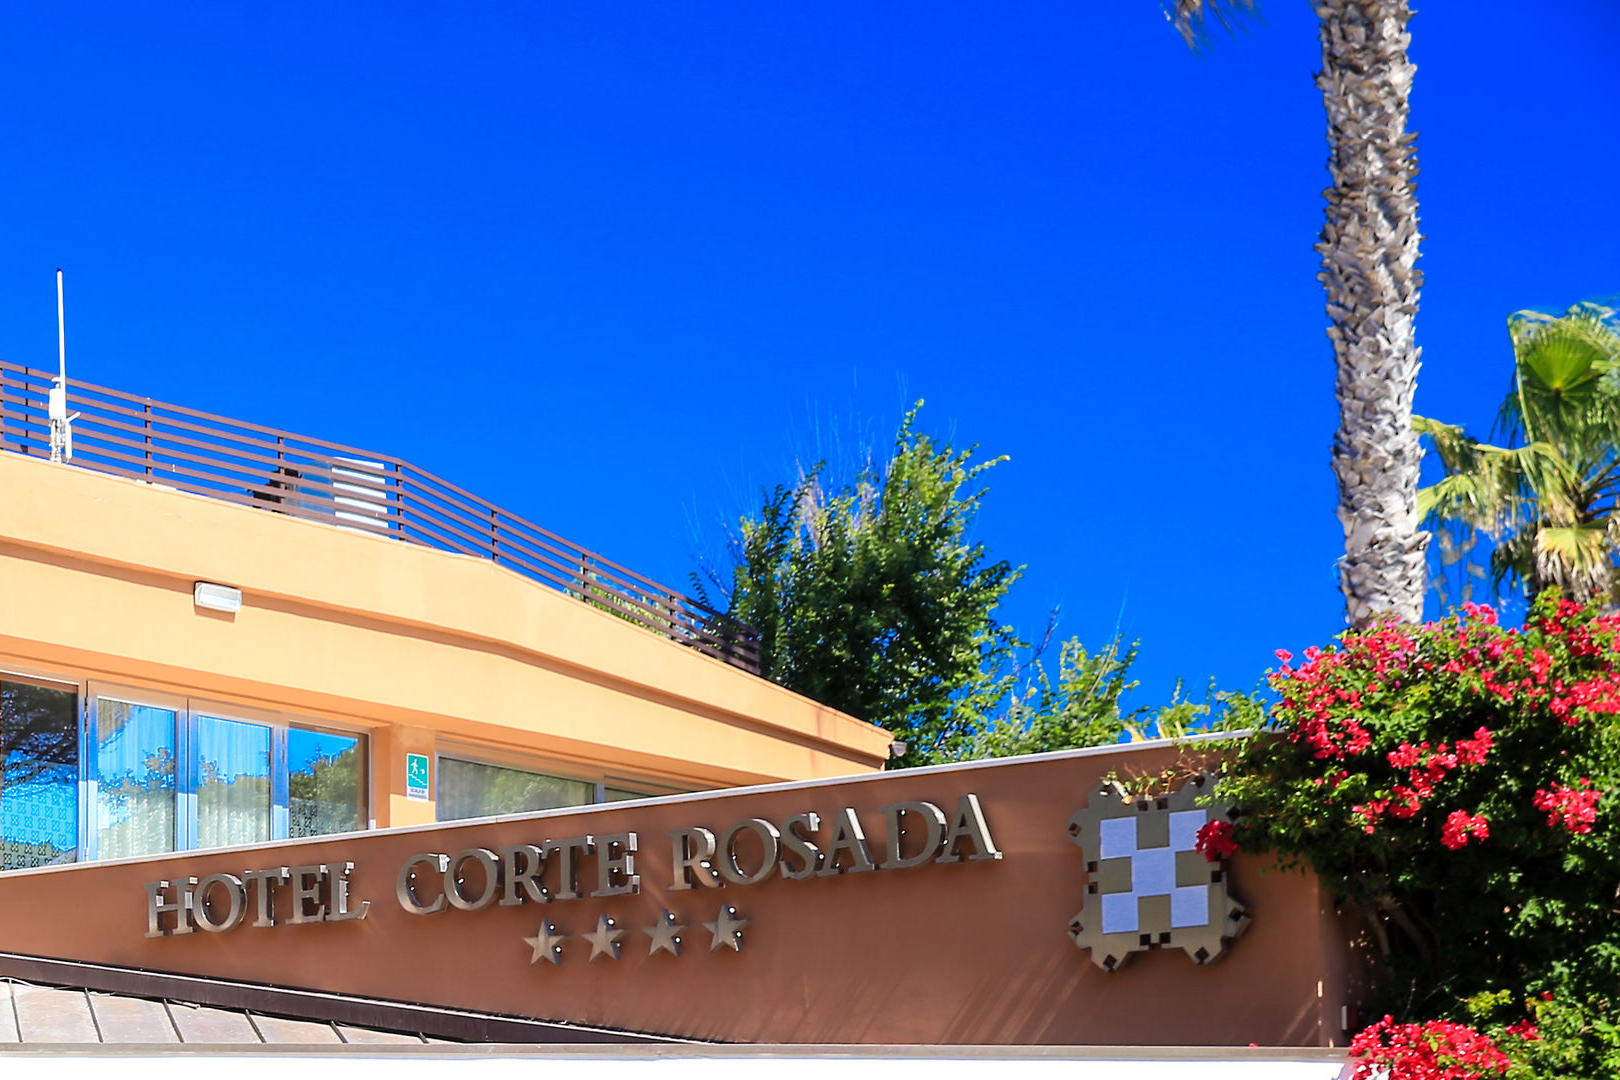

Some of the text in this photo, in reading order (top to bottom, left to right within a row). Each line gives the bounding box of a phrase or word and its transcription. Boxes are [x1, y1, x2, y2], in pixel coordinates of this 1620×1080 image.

[143, 794, 1003, 938] HOTEL CORTE ROSADA
